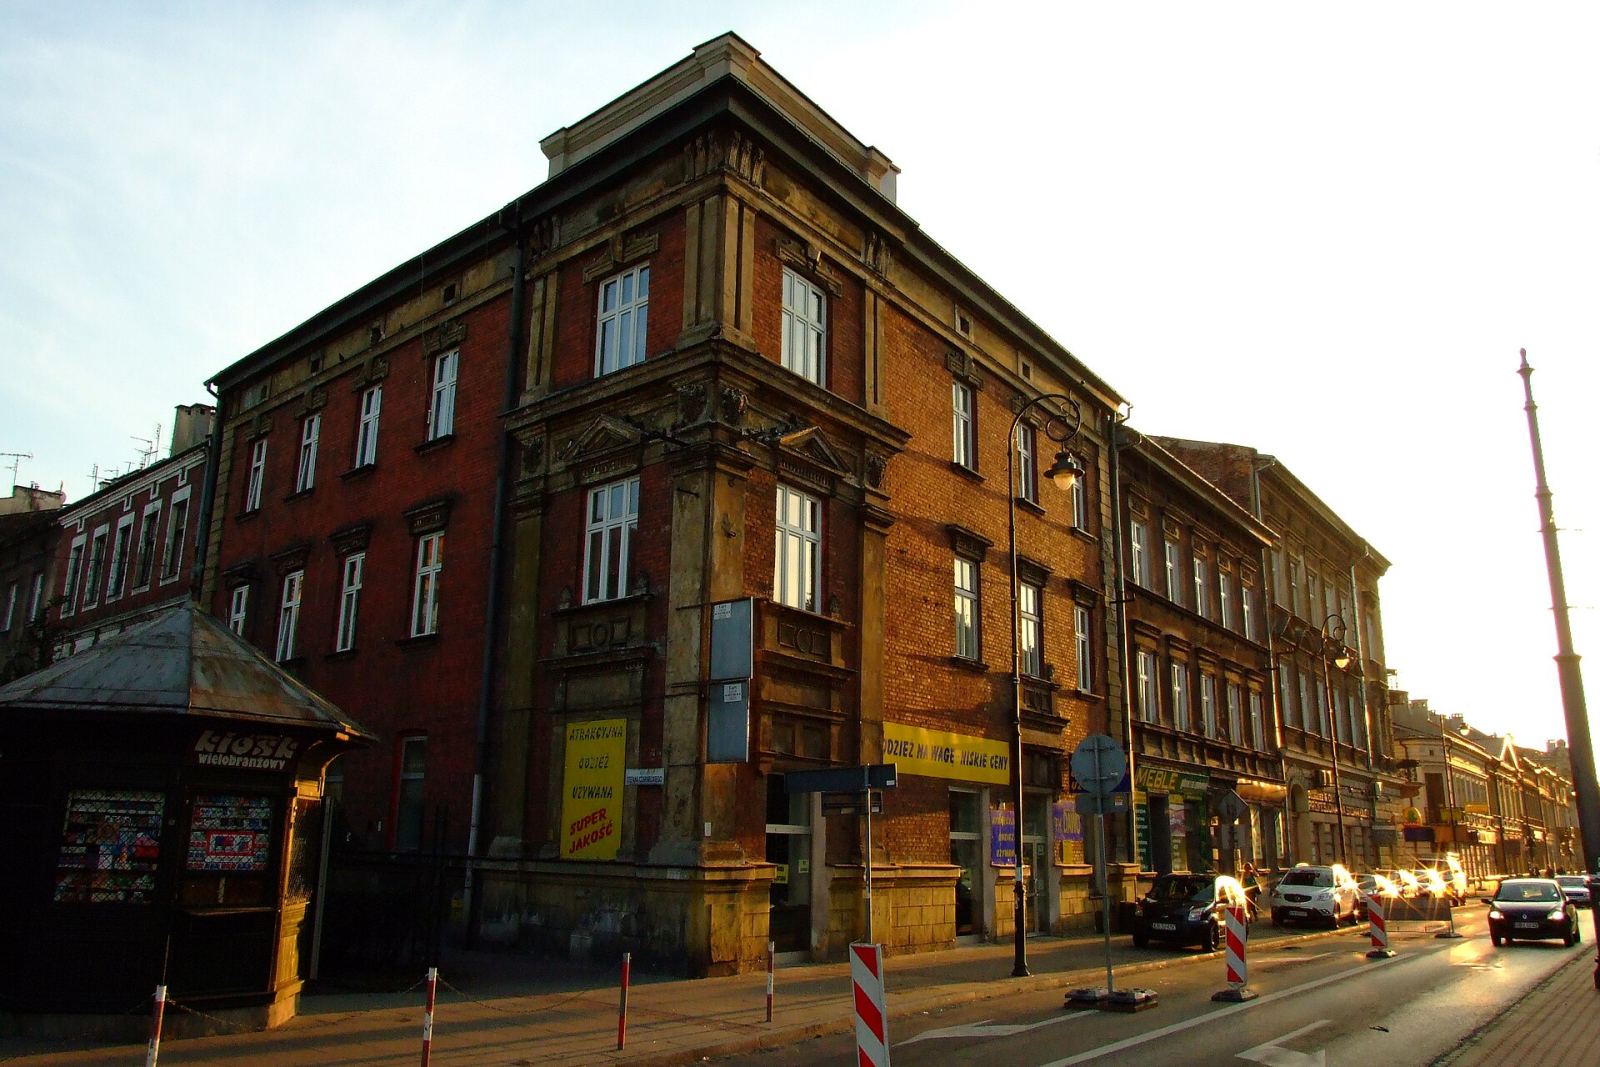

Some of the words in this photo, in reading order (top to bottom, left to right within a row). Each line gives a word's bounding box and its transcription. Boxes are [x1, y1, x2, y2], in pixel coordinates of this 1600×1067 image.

[569, 726, 623, 741] ATRAKCYJNA
[917, 743, 929, 760] NA
[960, 749, 987, 769] NISKIE
[989, 754, 1008, 771] CENY
[1135, 767, 1178, 790] MEBLE
[570, 808, 607, 836] SUPER
[569, 820, 614, 853] JAKOŚĆ
